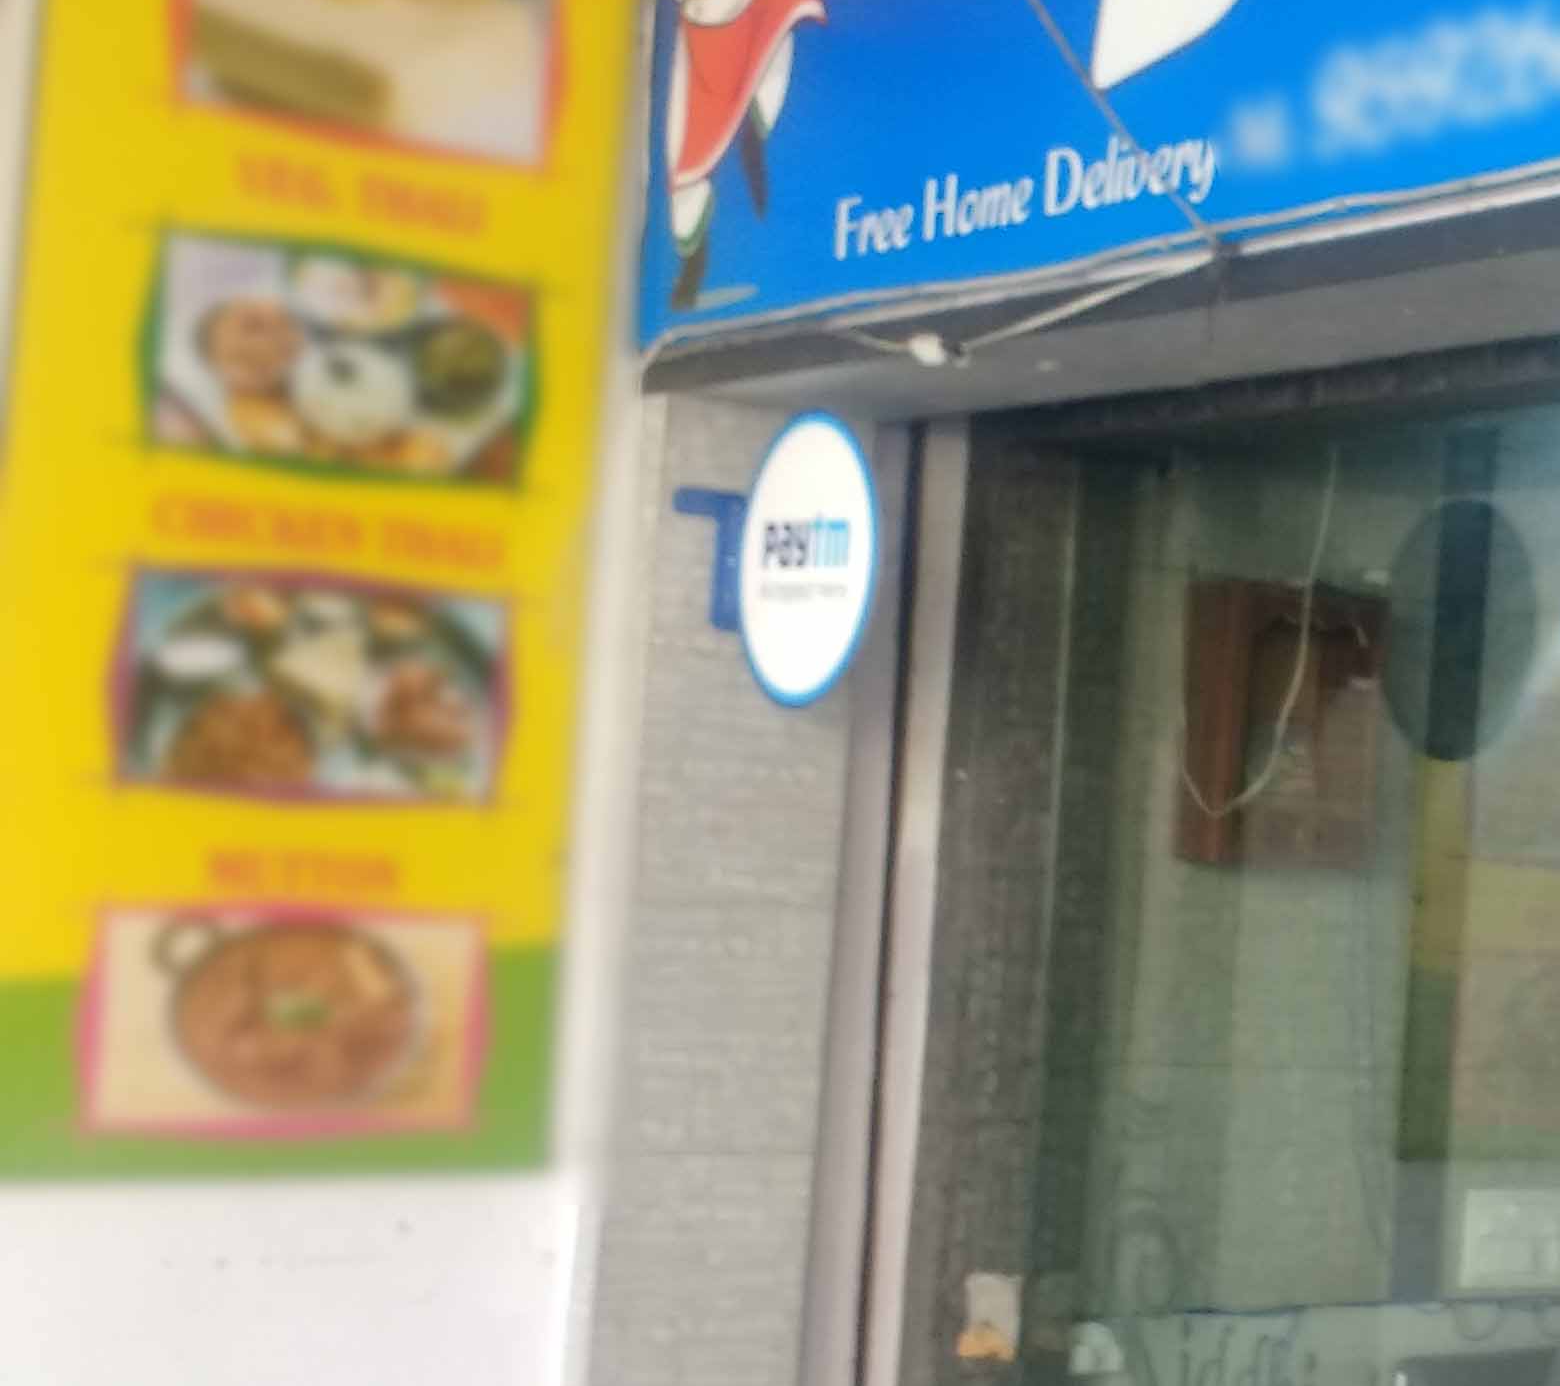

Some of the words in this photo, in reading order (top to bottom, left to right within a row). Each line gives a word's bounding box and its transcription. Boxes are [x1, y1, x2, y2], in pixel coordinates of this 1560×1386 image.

[833, 195, 915, 261] Free
[921, 173, 1034, 242] Home
[1042, 136, 1216, 217] Delivery
